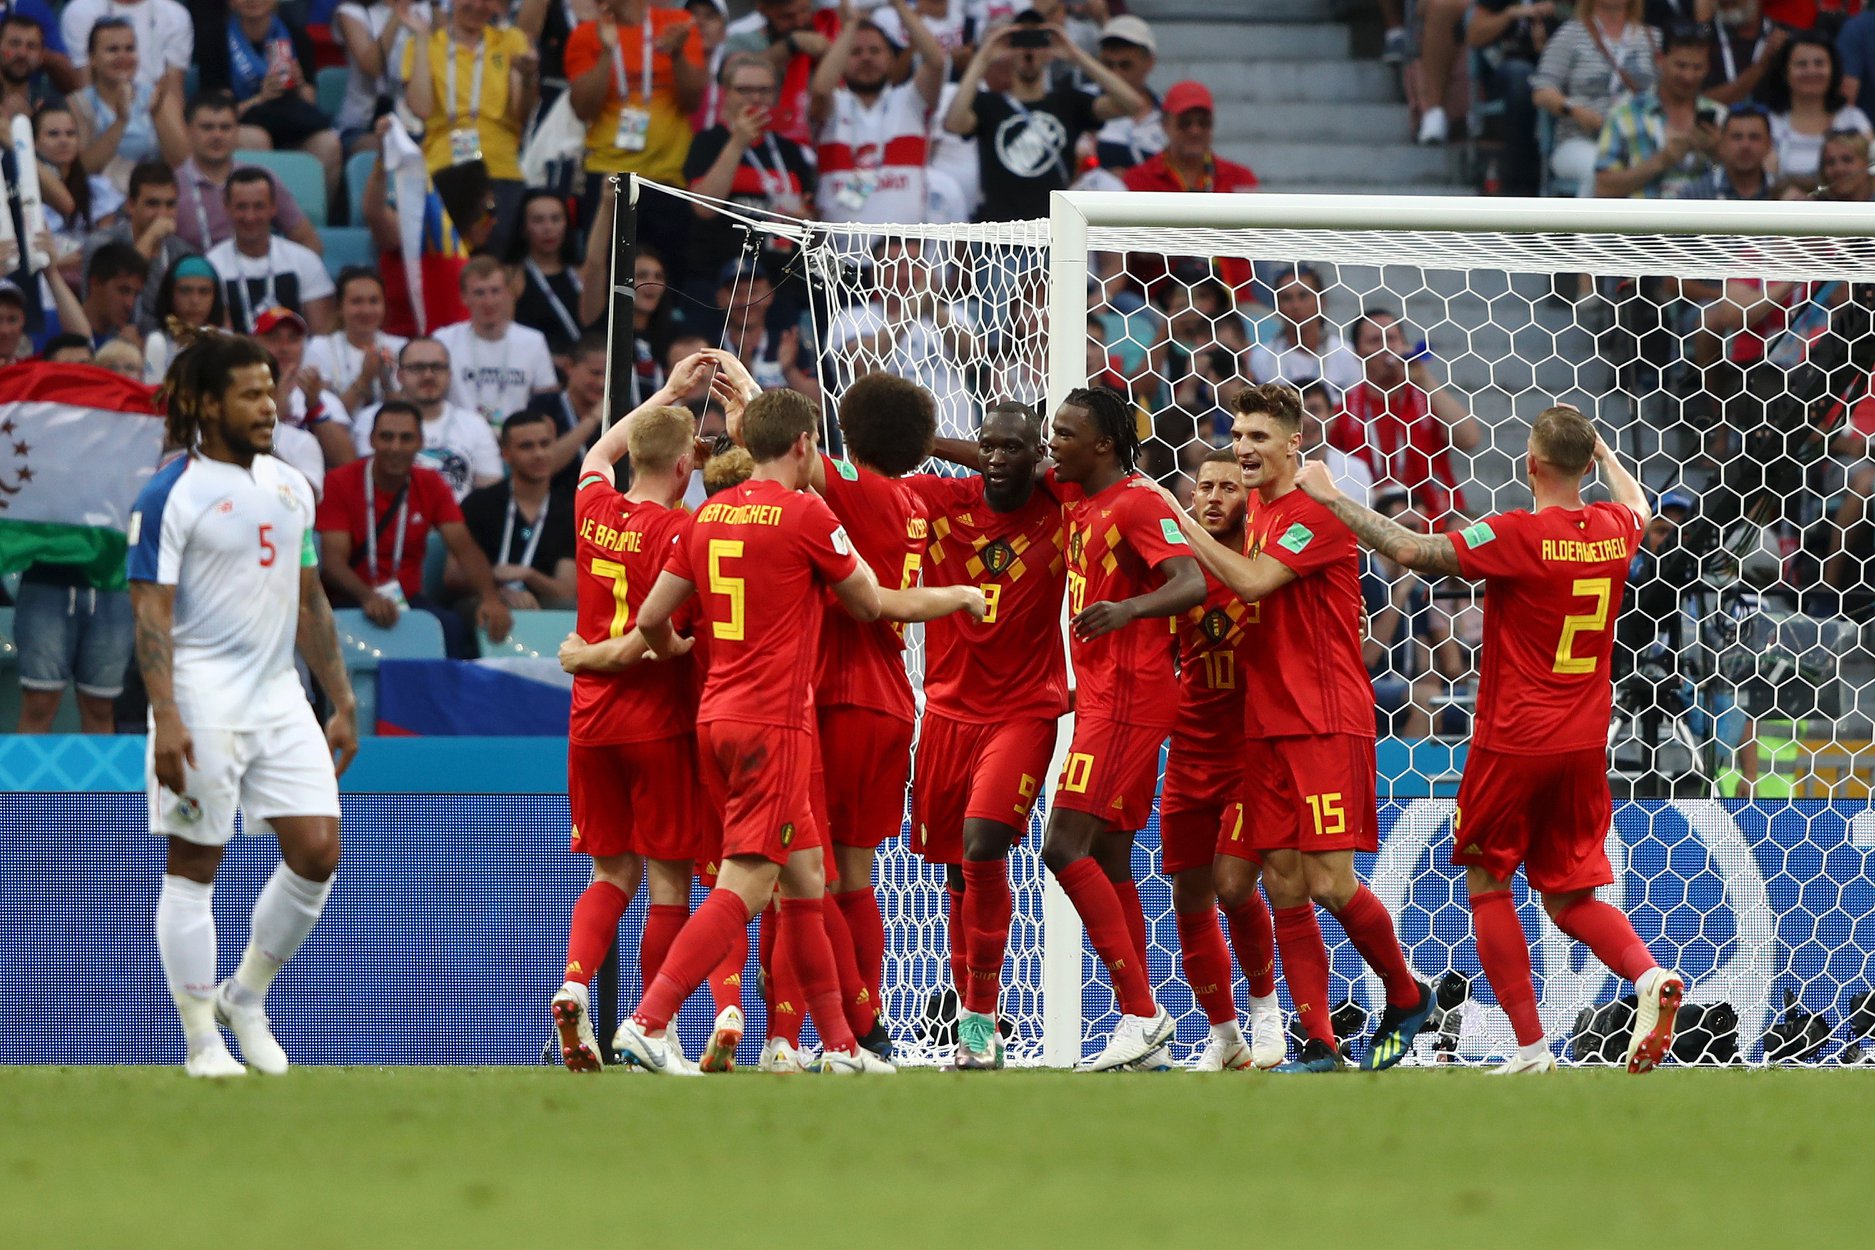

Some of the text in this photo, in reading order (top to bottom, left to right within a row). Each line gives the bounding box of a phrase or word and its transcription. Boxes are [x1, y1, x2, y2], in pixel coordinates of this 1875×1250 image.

[258, 524, 277, 568] 5
[590, 557, 630, 639] 7
[708, 538, 745, 641] 5
[1551, 577, 1612, 674] 2
[1199, 650, 1236, 689] 10
[1013, 772, 1037, 816] 9
[1305, 792, 1346, 835] 15
